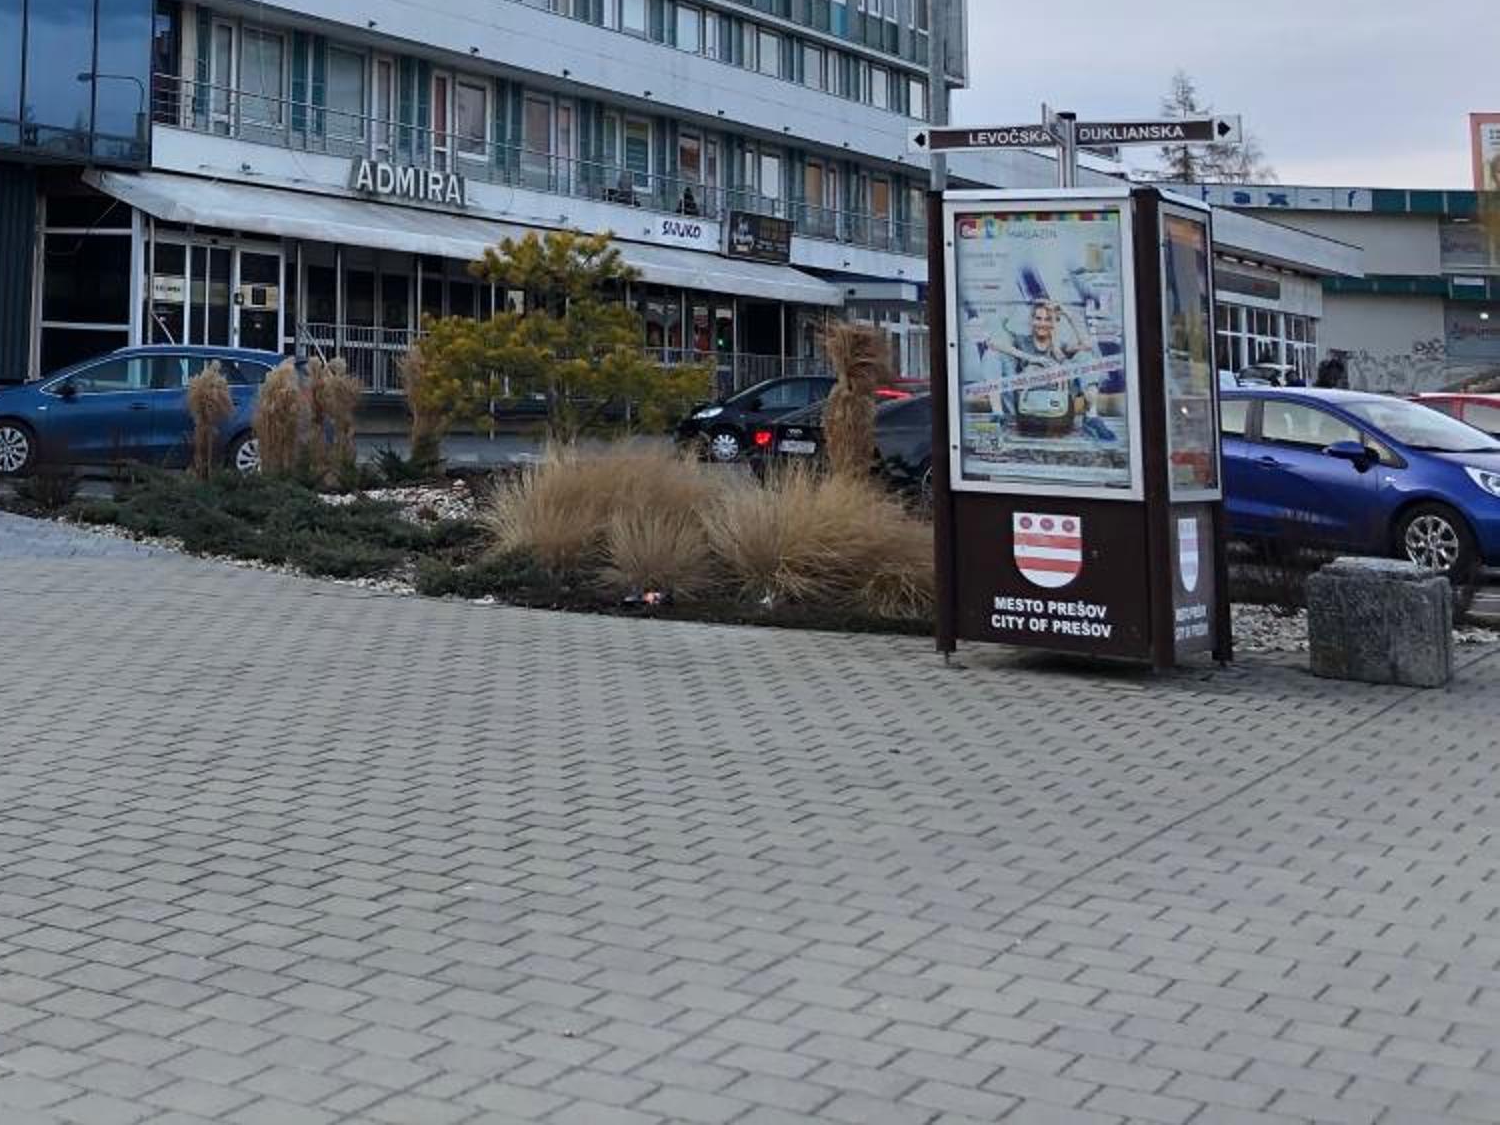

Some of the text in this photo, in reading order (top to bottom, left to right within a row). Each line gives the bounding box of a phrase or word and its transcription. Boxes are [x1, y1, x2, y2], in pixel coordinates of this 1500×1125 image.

[1079, 124, 1185, 142] DUKLIANSKA
[355, 157, 477, 206] ADMIRAL
[994, 596, 1107, 619] MESTO PREŠOV
[991, 614, 1112, 639] CITY OF PREŠOV
